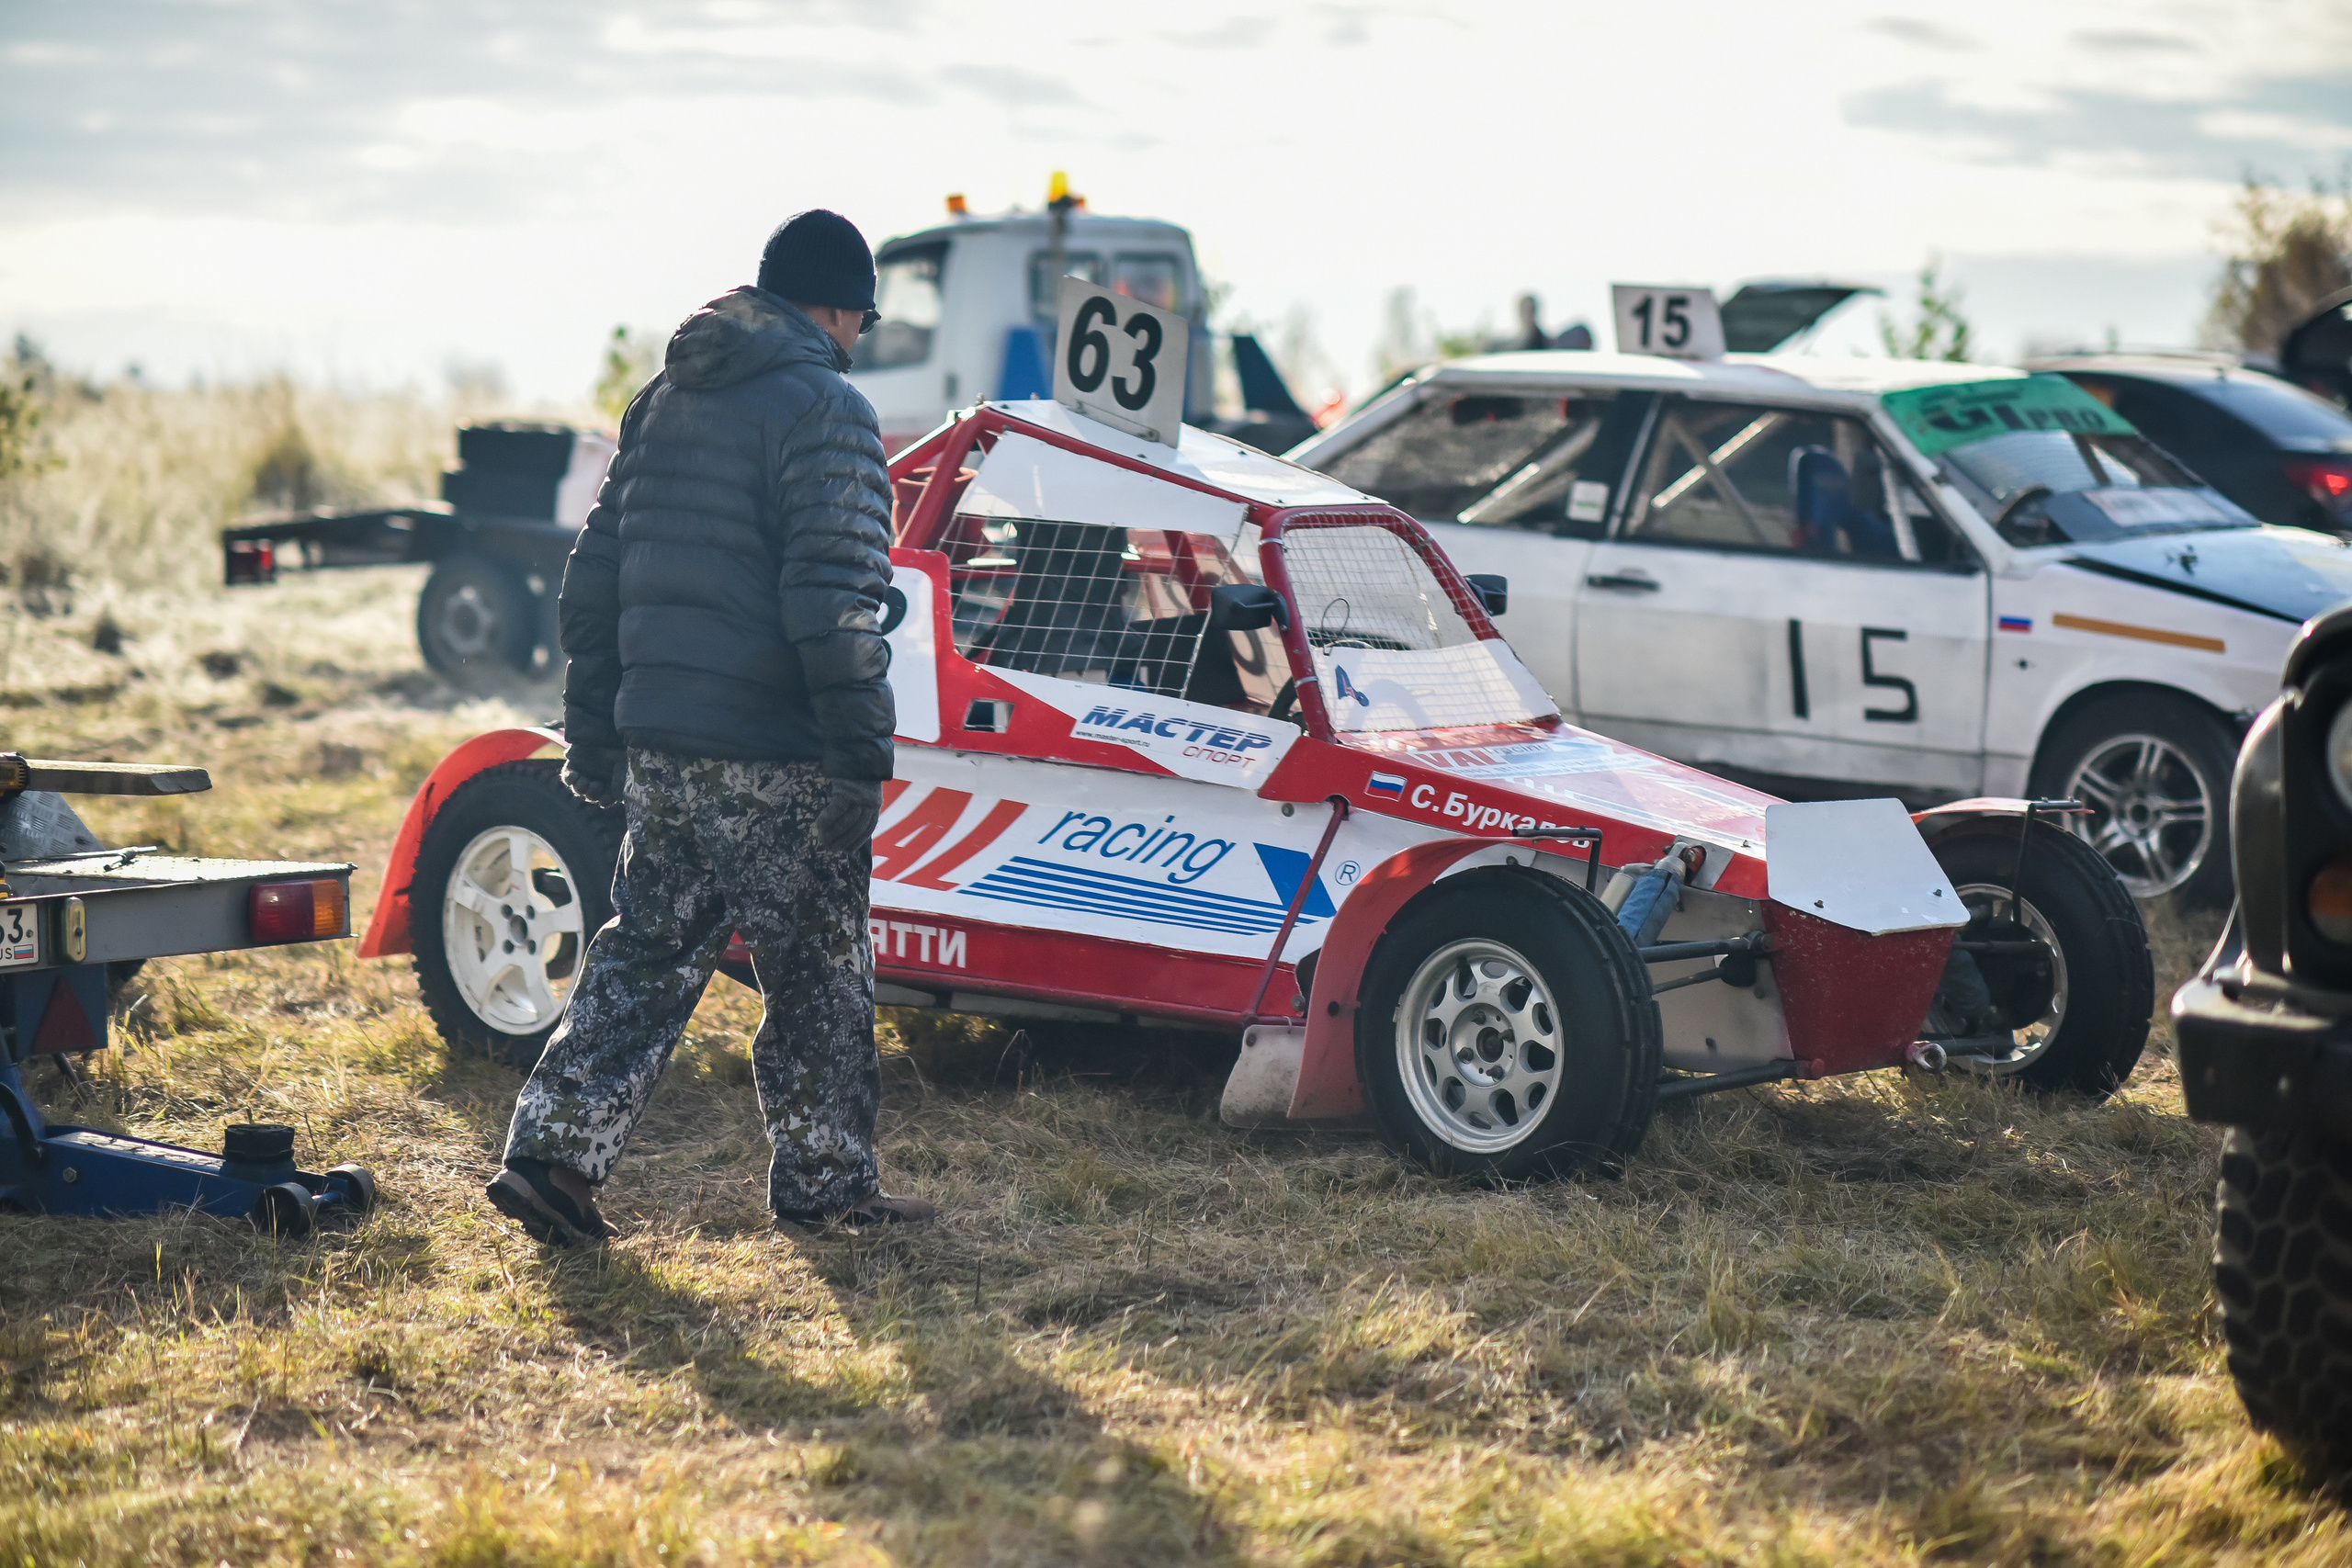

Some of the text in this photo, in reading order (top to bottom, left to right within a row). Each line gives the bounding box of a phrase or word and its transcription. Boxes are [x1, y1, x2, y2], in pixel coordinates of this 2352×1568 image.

[1631, 295, 1691, 349] 15
[1067, 295, 1163, 412] 63
[1788, 617, 1918, 723] 15
[1075, 730, 1150, 748] www.master-sport.ru
[1080, 705, 1273, 752] МАСТЕР
[1182, 745, 1256, 769] СПОРТ
[1422, 748, 1510, 768] VAL
[1037, 810, 1237, 885] racing
[0, 908, 24, 944] 3
